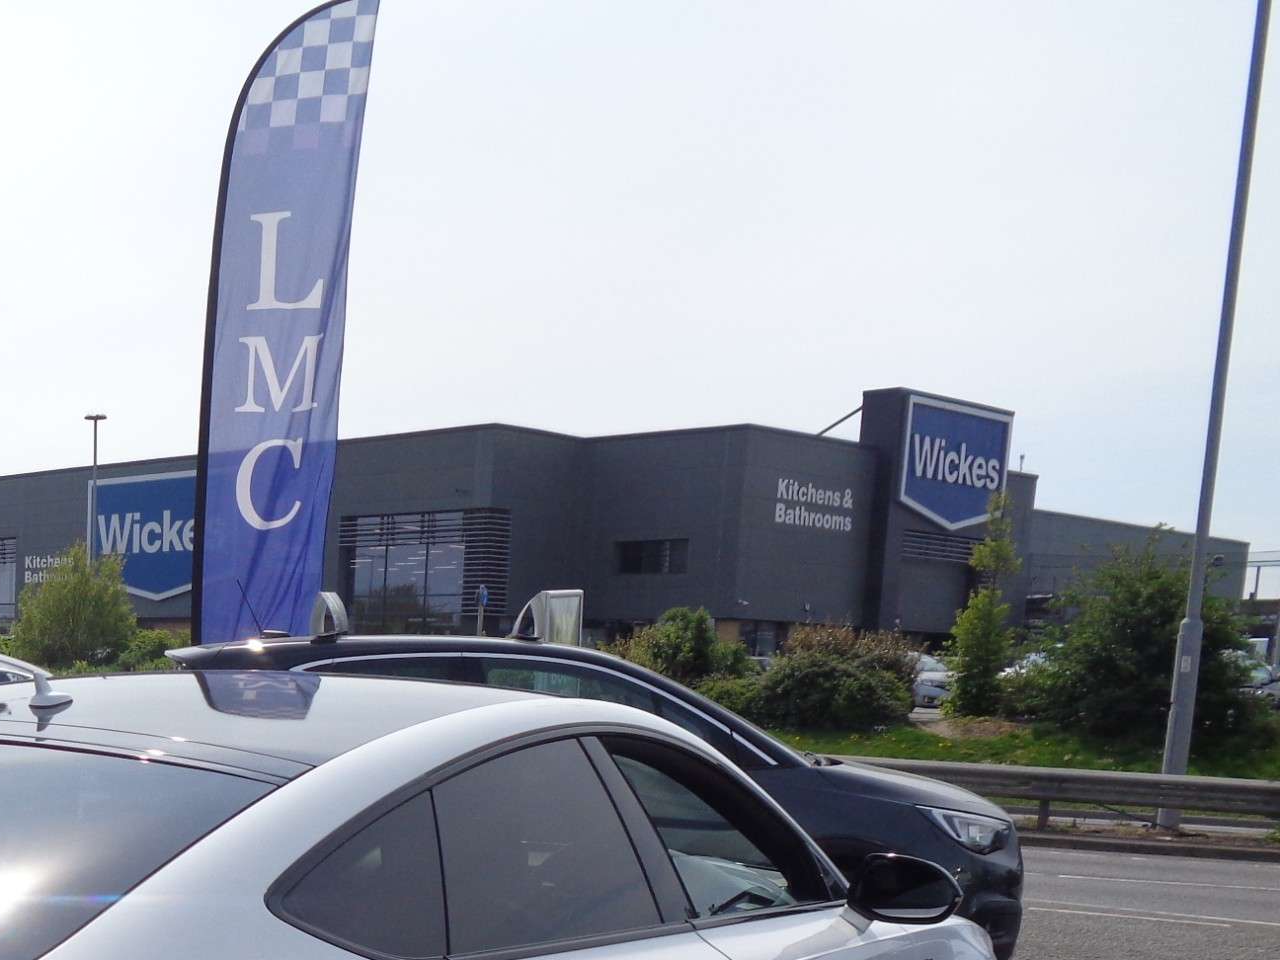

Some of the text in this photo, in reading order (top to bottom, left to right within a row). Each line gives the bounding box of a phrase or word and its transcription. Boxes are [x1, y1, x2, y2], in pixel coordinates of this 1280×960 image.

[234, 210, 324, 531] LMC
[913, 433, 1001, 491] Wickes
[776, 477, 854, 509] Kitchens &
[97, 509, 196, 555] Wicke
[774, 502, 853, 532] Bathrooms
